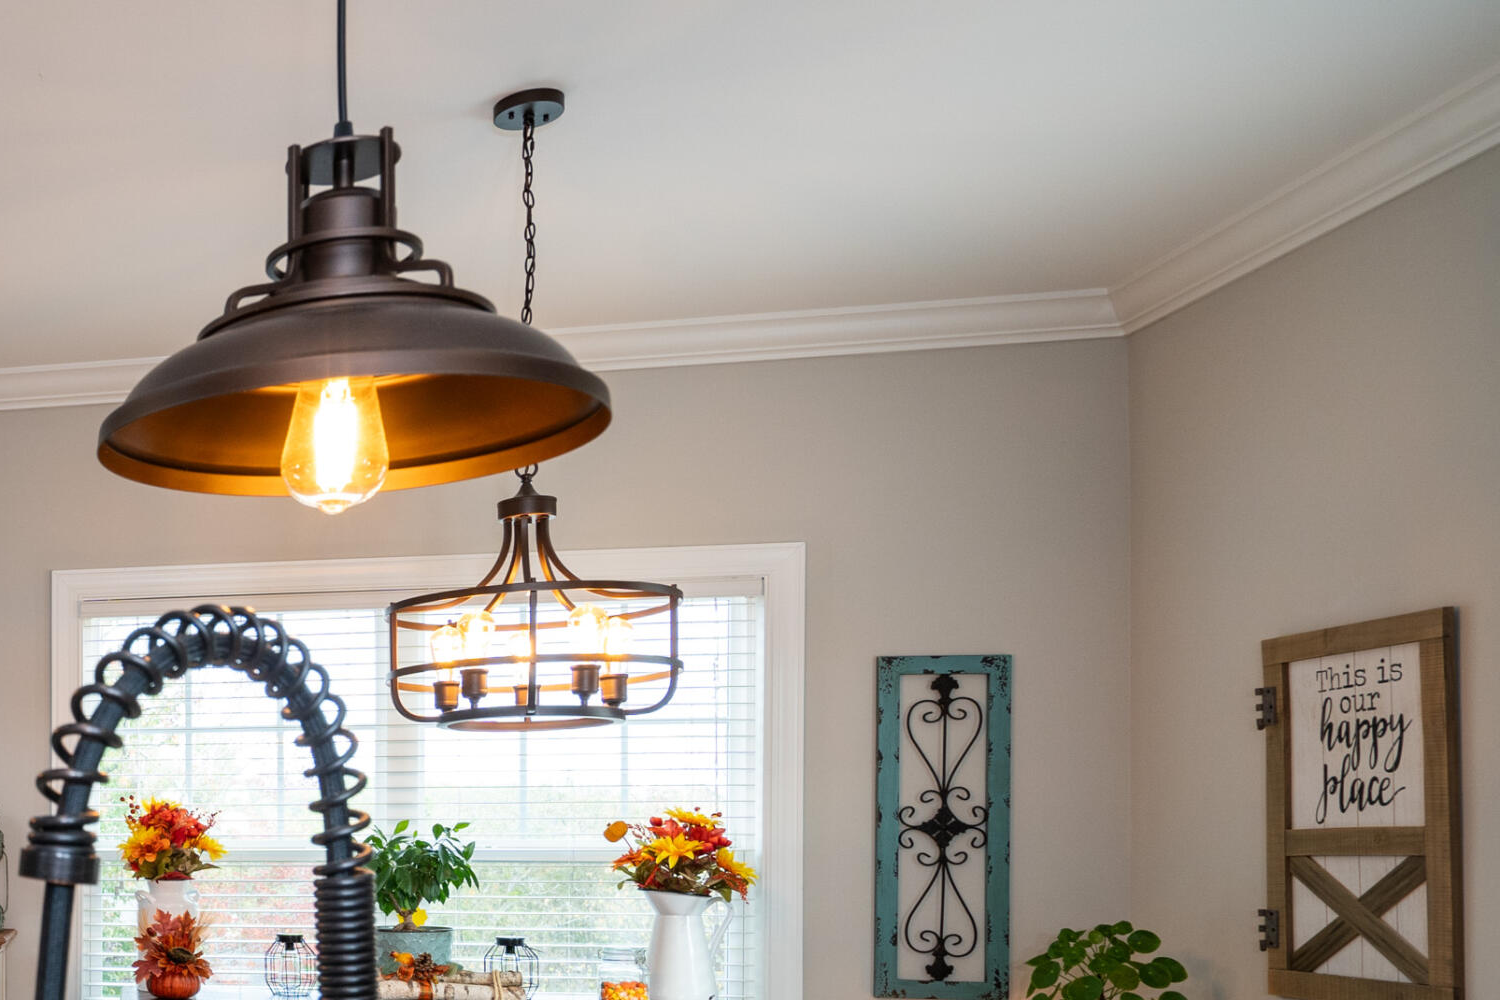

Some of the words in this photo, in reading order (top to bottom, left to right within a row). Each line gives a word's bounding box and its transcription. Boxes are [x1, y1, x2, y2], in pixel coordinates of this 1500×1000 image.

[1316, 663, 1367, 694] This
[1377, 658, 1403, 685] is
[1339, 691, 1381, 714] our
[1320, 696, 1413, 773] happy
[1315, 753, 1407, 825] place
